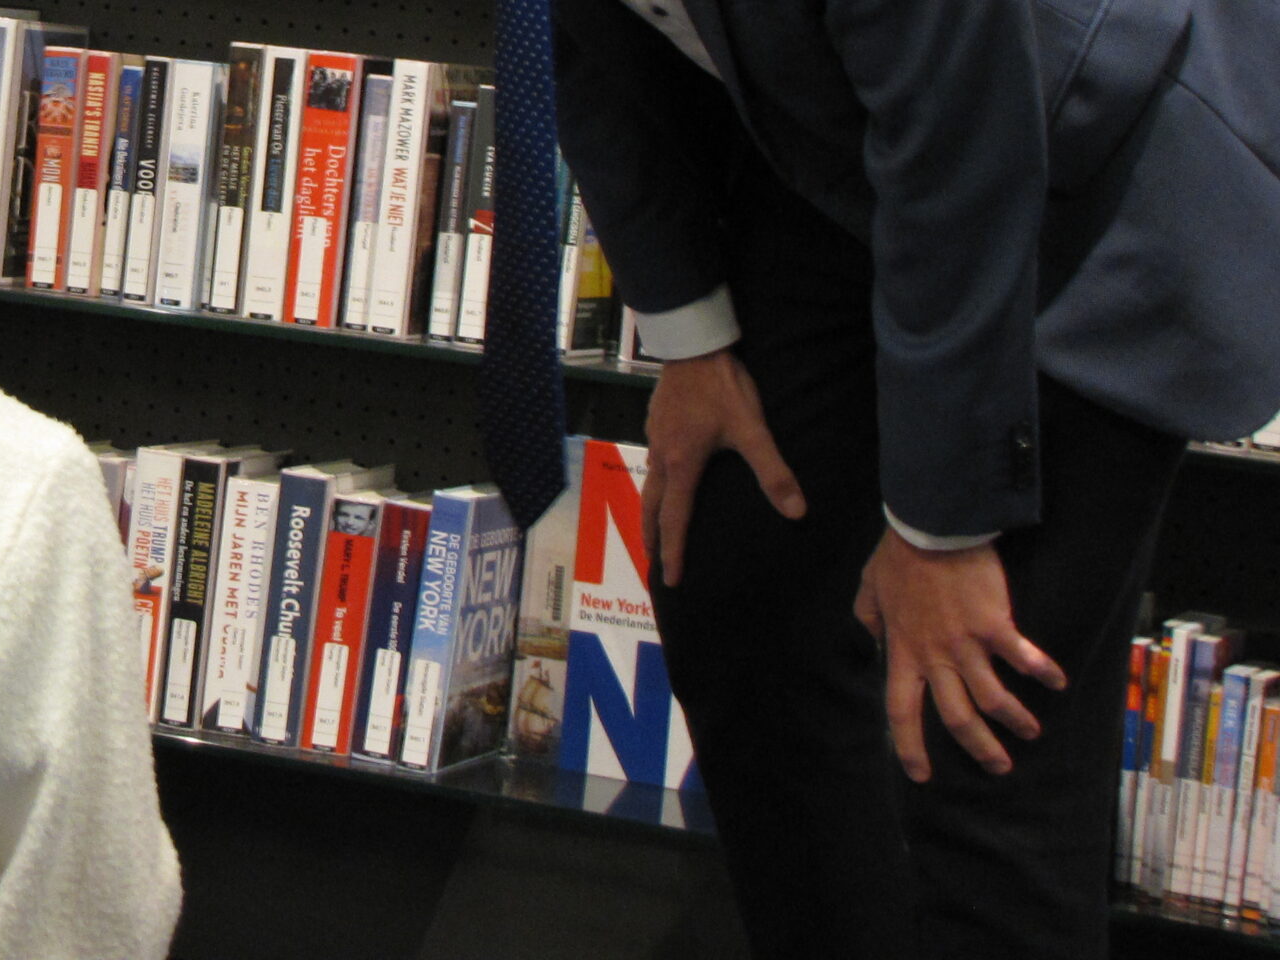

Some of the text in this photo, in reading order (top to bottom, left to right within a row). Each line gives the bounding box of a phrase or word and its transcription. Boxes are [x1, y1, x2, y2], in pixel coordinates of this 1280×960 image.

[400, 73, 417, 105] MARK
[188, 90, 201, 129] Katerina
[273, 93, 287, 121] Pieter
[80, 118, 101, 157] TRANEN
[117, 136, 128, 149] Alle
[272, 122, 283, 140] van
[393, 106, 414, 160] MAZOWER
[271, 141, 282, 154] Os
[304, 146, 322, 173] het
[484, 144, 494, 162] EVA
[227, 161, 240, 190] MEISJE
[322, 143, 347, 218] Dochters
[390, 166, 408, 189] WAT
[389, 190, 406, 202] JE
[182, 492, 193, 505] hel
[184, 480, 194, 491] De
[148, 476, 173, 564] HET HUIS TRUMP
[181, 506, 189, 515] en
[232, 490, 250, 527] MIJN
[132, 481, 156, 570] HET HUIS POETIN
[186, 482, 215, 606] MADELEINE ALBRIGHT
[226, 532, 246, 582] JAREN
[243, 492, 270, 620] BEN RHODES
[341, 539, 353, 562] MARY
[170, 544, 187, 602] bestemmingen
[396, 556, 408, 583] Verdel
[417, 529, 448, 632] NEW YORK
[436, 533, 460, 635] DE GEBOORTE VAN
[463, 545, 518, 607] NEW
[337, 572, 349, 602] TRUMP
[223, 586, 240, 619] MET
[335, 606, 347, 618] Te
[391, 601, 402, 614] De
[579, 610, 594, 622] De
[580, 592, 651, 617] New York
[331, 619, 345, 641] veel
[456, 604, 518, 667] YORK
